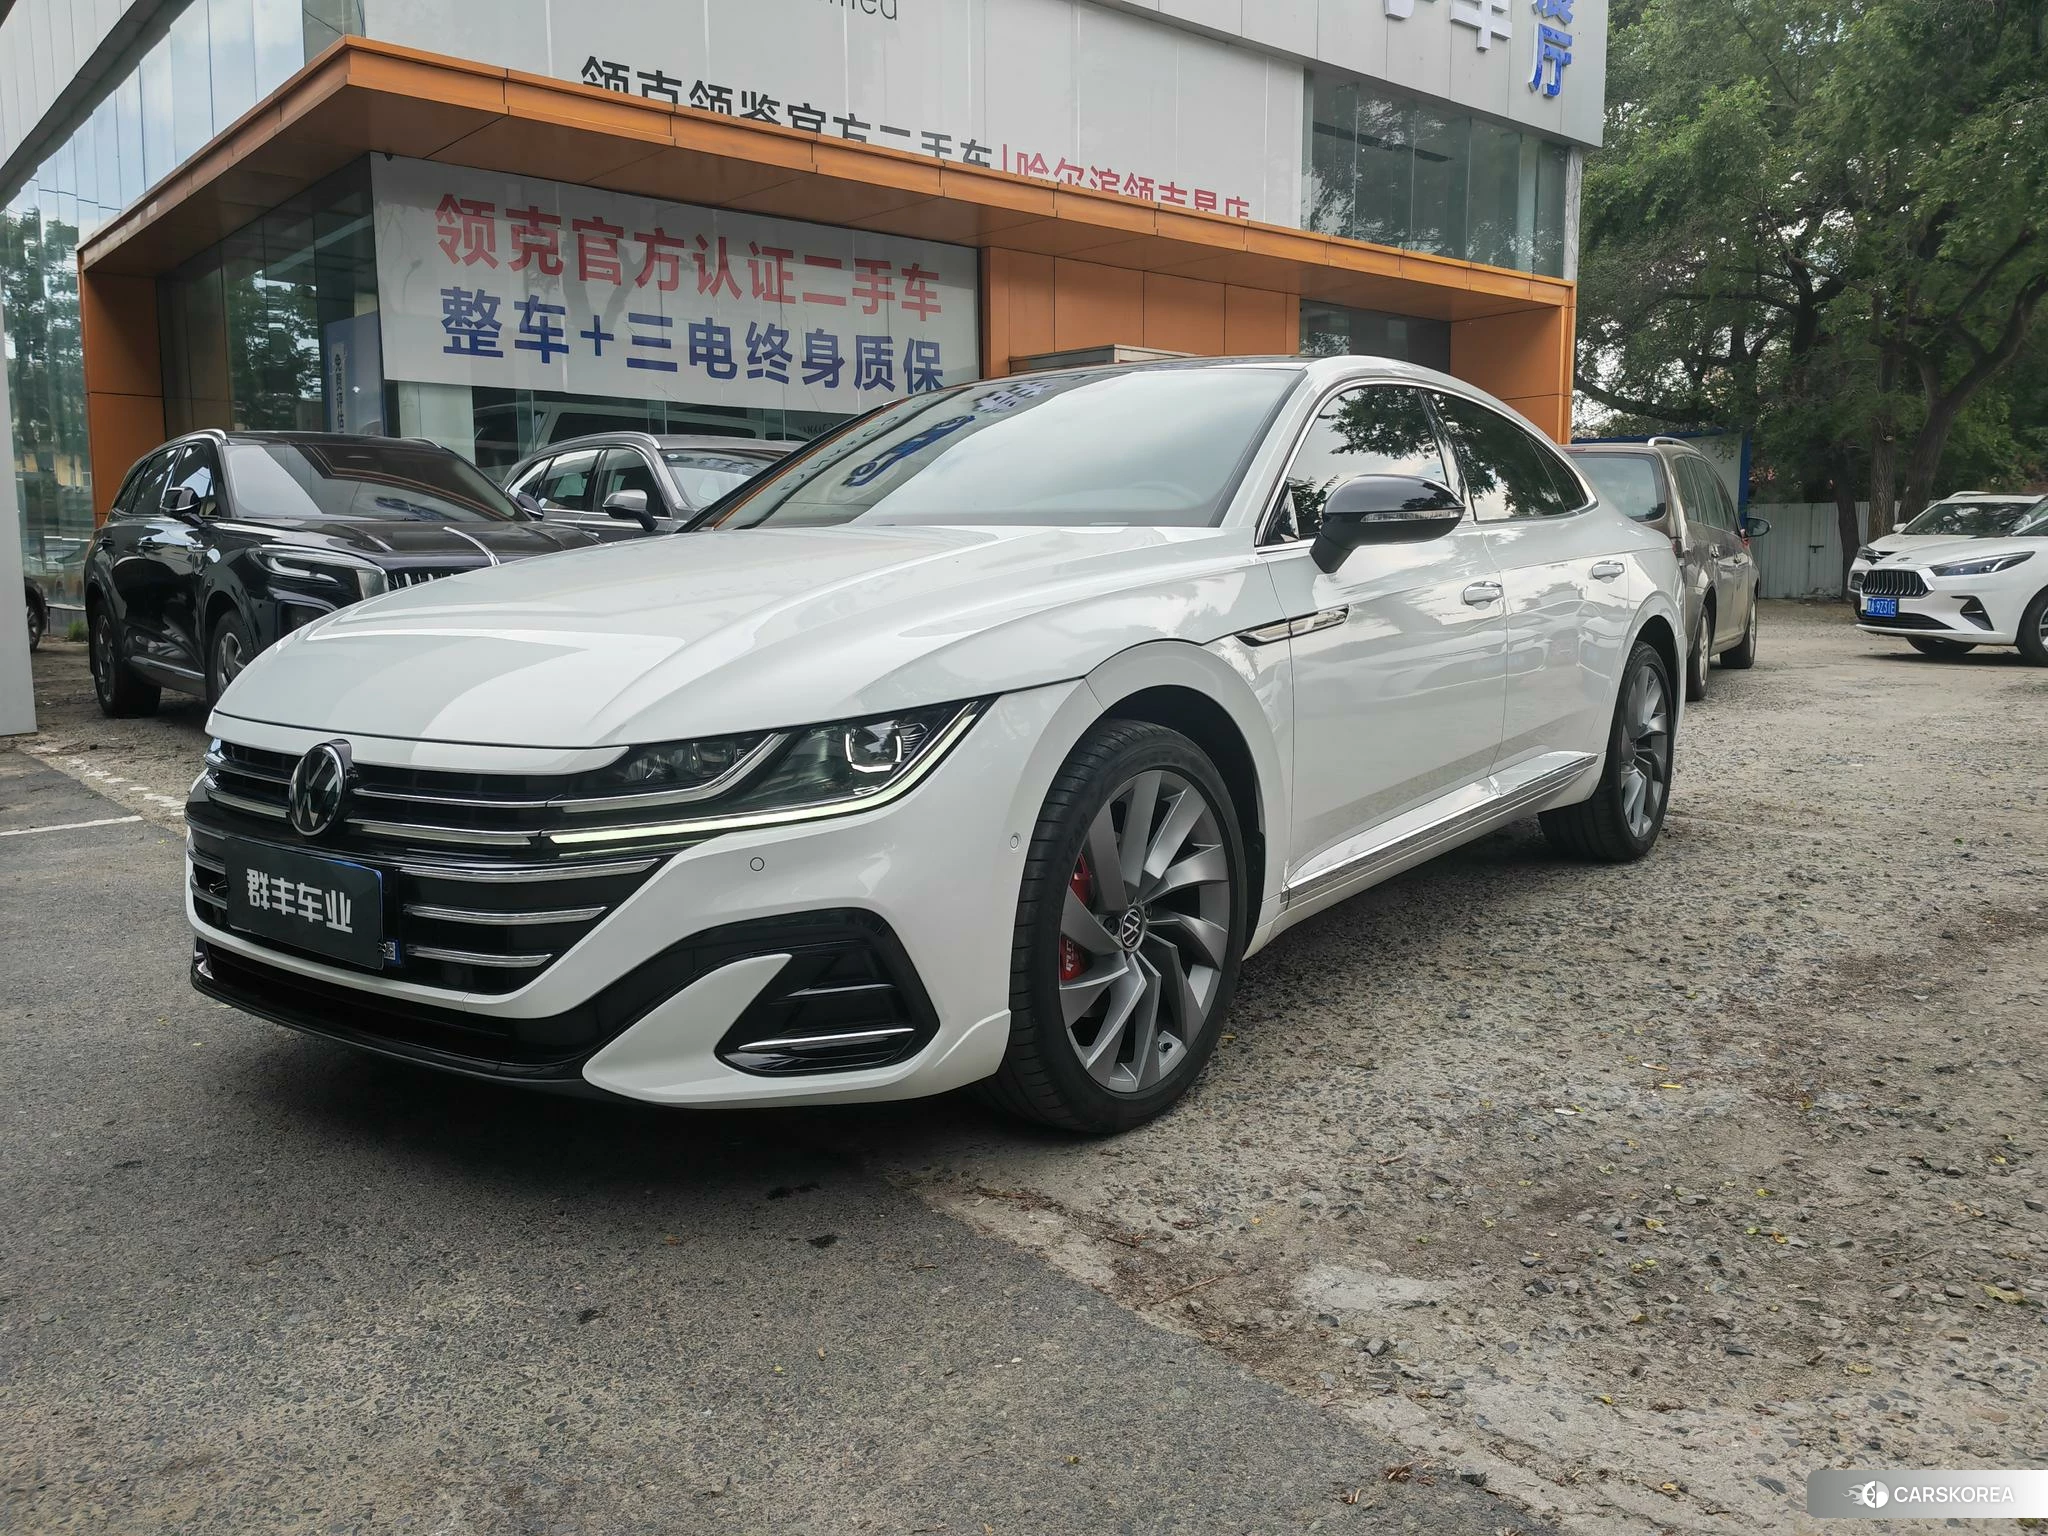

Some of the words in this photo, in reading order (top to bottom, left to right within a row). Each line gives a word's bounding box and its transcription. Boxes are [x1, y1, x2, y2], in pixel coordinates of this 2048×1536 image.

[434, 192, 942, 322] 领克官方认证二手车
[440, 286, 945, 395] 整车+三电终身质保
[334, 353, 345, 433] 免费评估
[246, 868, 353, 934] 群丰车业
